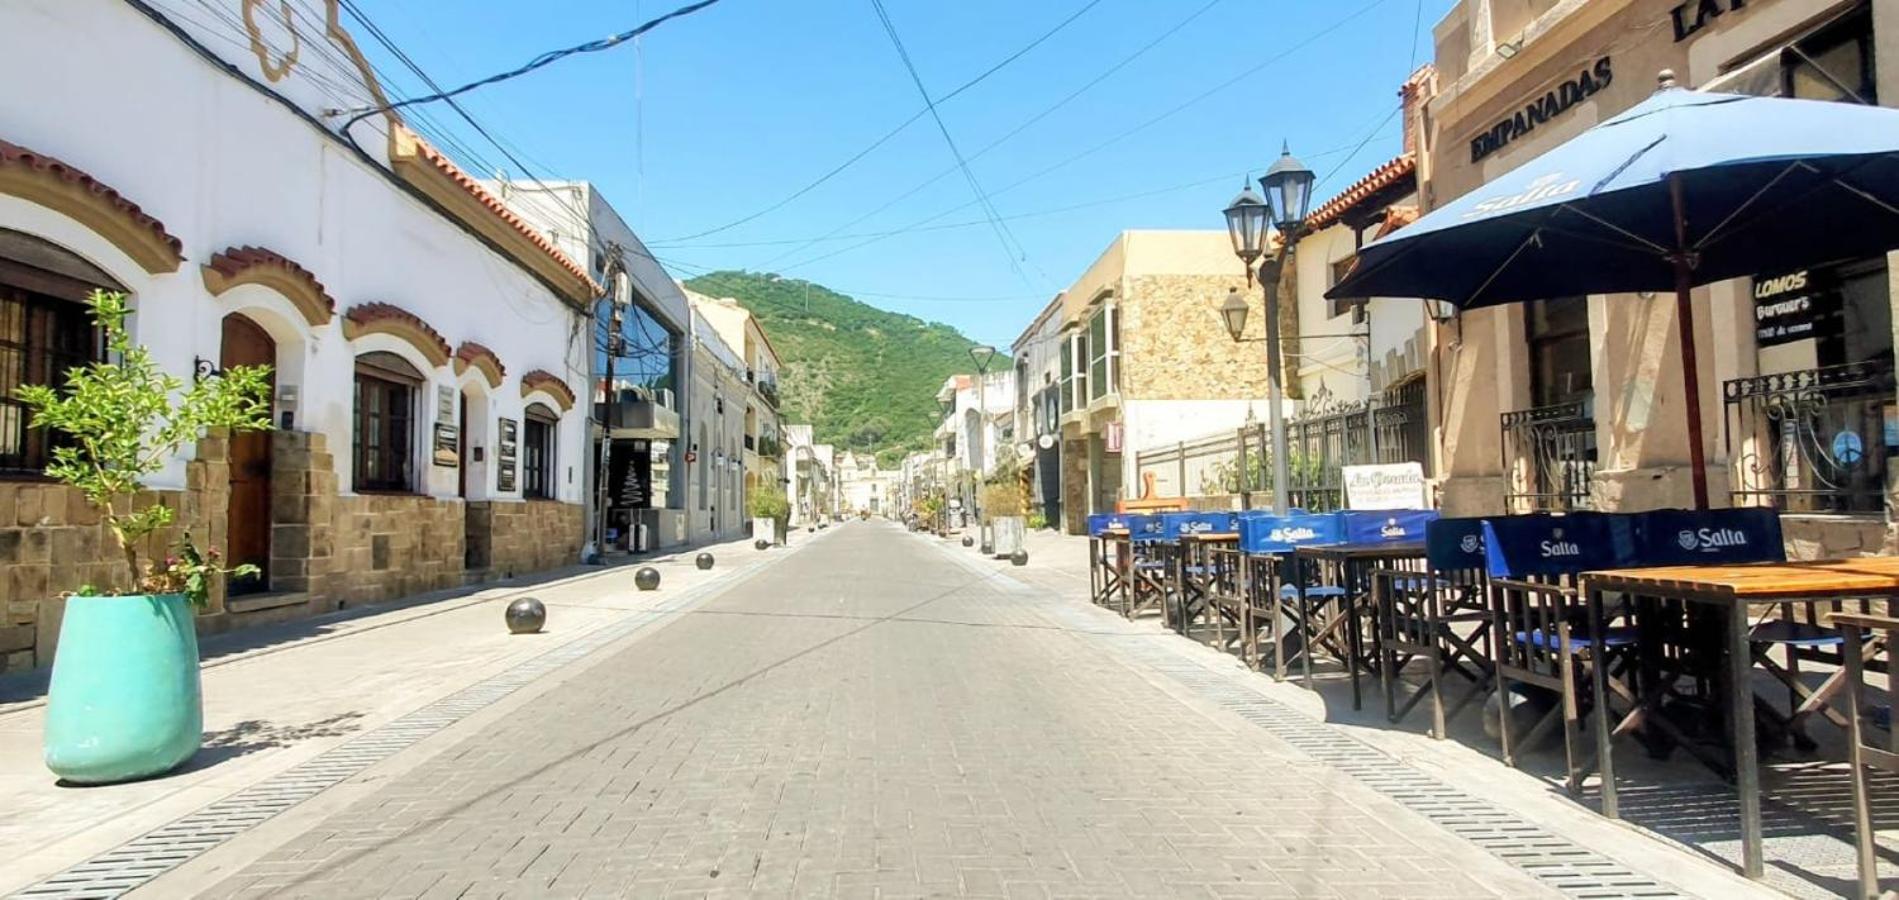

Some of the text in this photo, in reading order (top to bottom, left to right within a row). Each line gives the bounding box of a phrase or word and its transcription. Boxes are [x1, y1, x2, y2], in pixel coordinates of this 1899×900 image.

[1470, 56, 1613, 164] EMPANADAS
[1755, 270, 1808, 298] LOMOS
[1541, 541, 1579, 557] Salta
[1698, 528, 1746, 548] Salta
